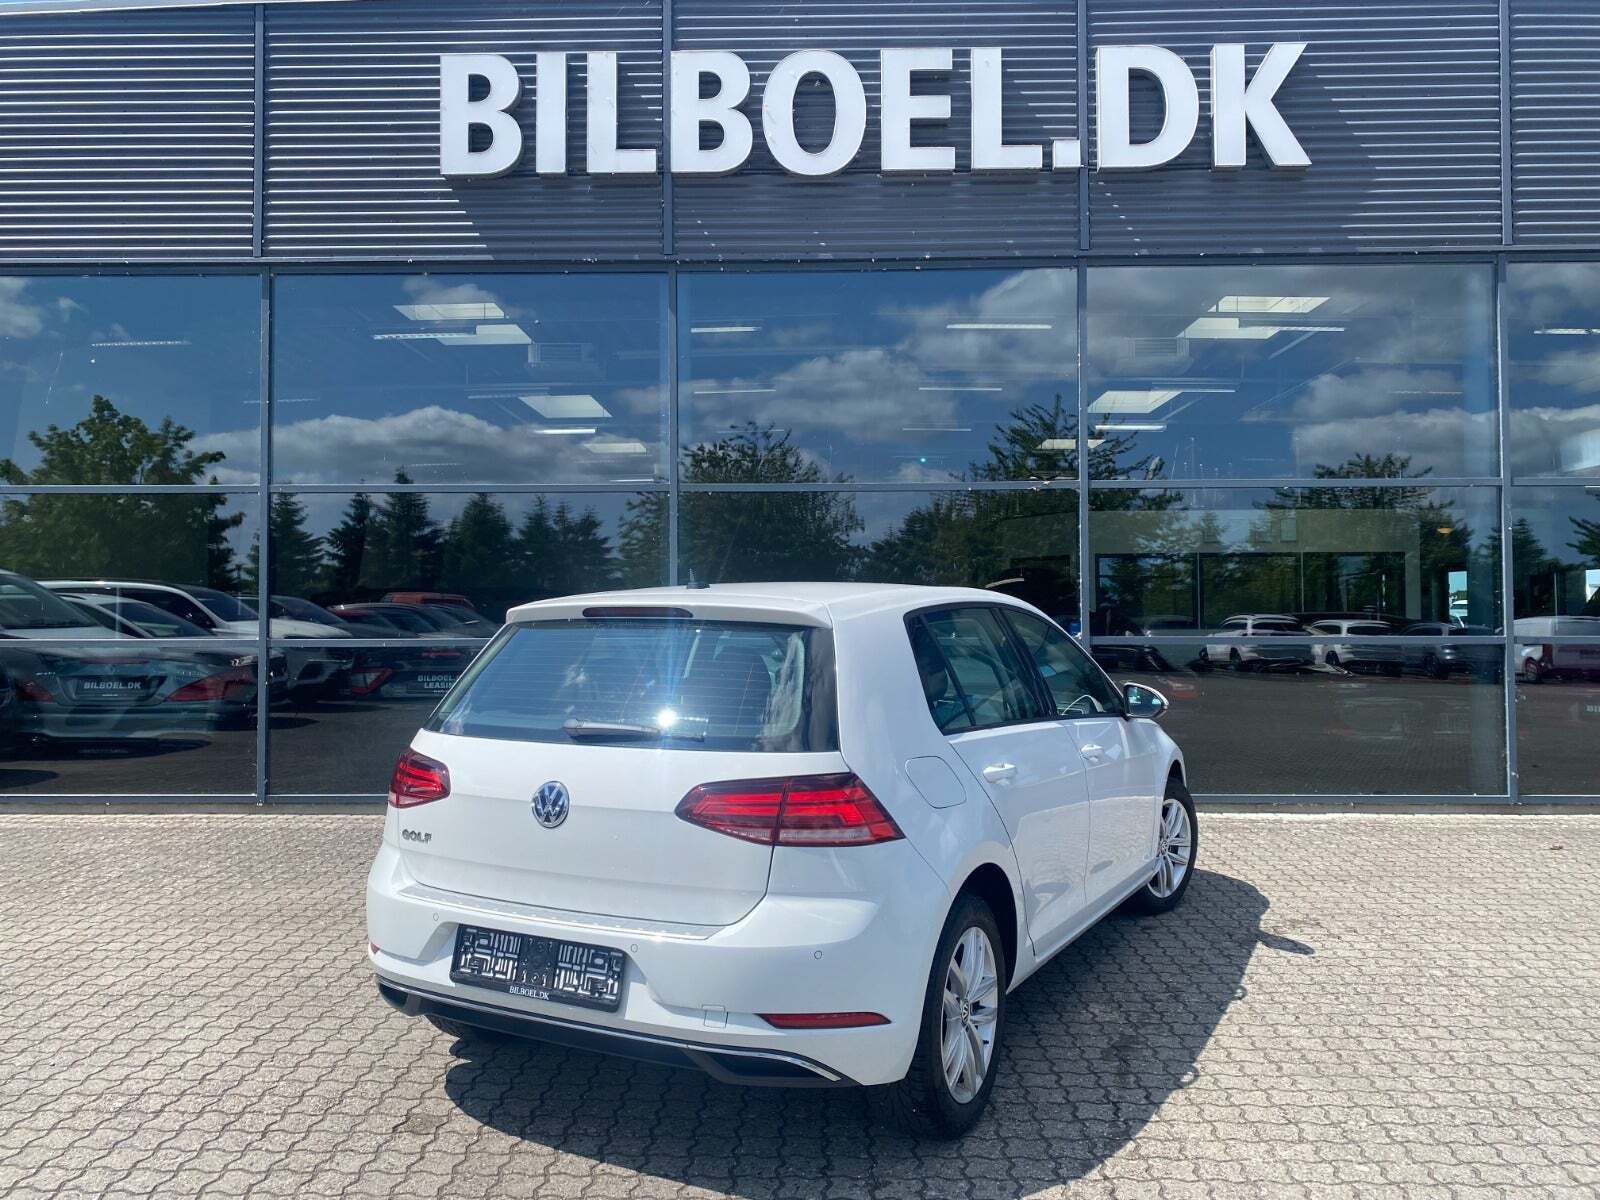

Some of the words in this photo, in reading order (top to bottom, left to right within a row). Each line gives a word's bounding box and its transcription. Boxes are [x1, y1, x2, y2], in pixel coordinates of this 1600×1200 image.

[439, 41, 1312, 177] BILBOEL.DK
[401, 828, 432, 844] GOLF
[509, 986, 550, 1001] BILBOEL.DK
